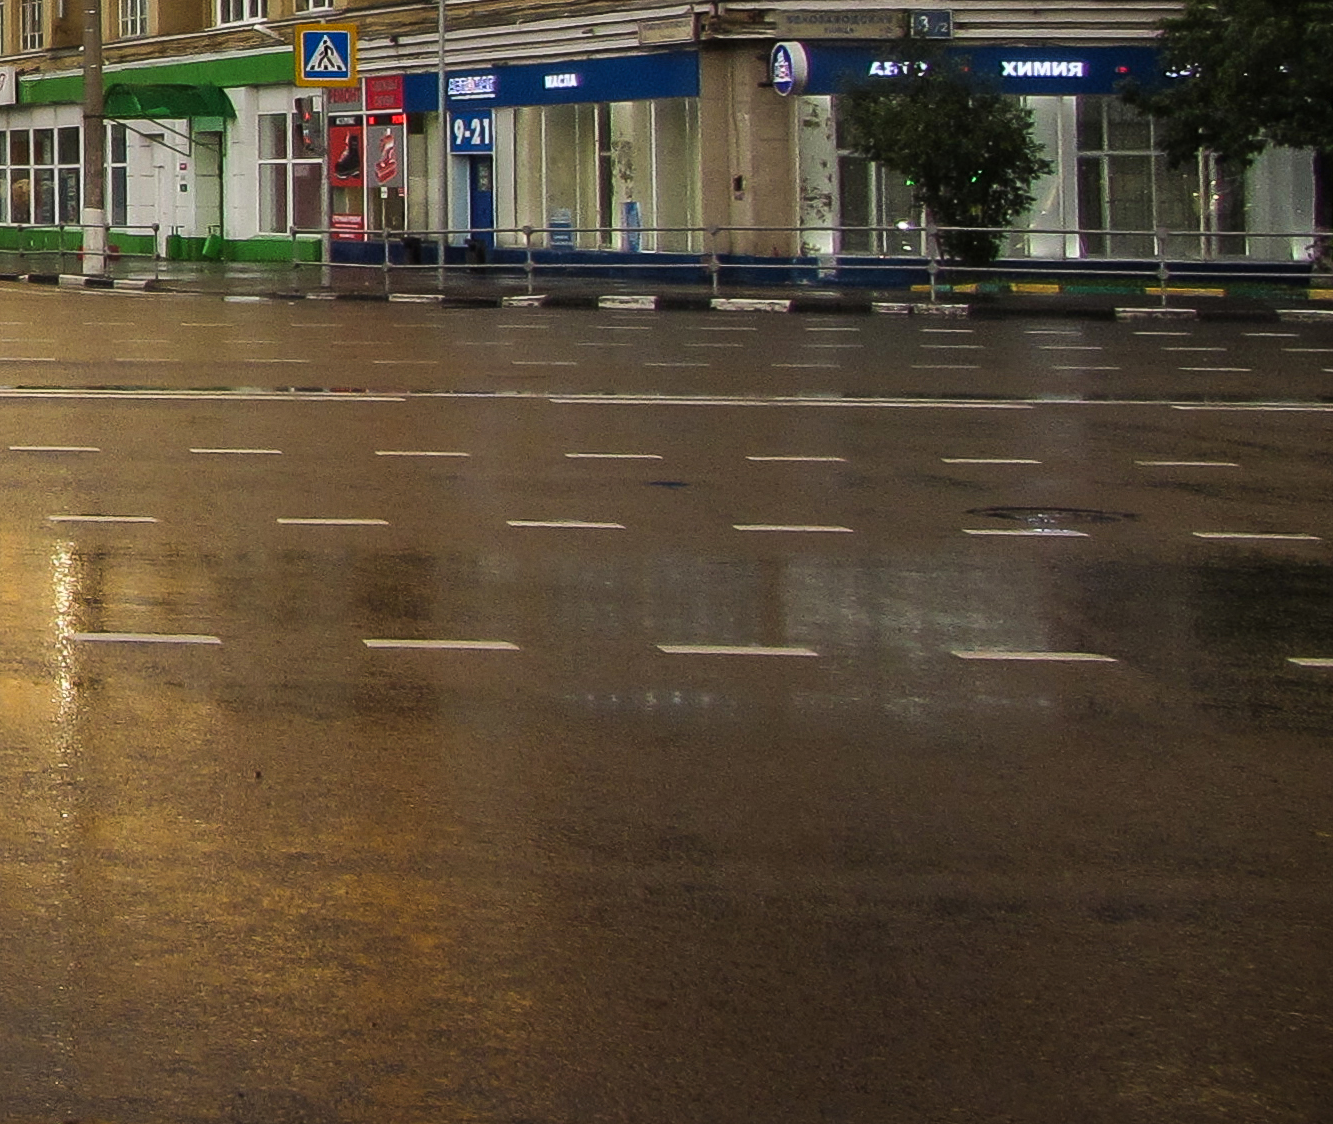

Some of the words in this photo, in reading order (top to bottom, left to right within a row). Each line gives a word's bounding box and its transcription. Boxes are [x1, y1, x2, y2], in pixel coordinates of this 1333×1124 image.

[1001, 61, 1083, 77] ХИМИЯ
[544, 73, 577, 89] МАСЛА
[453, 118, 490, 145] 9-21
